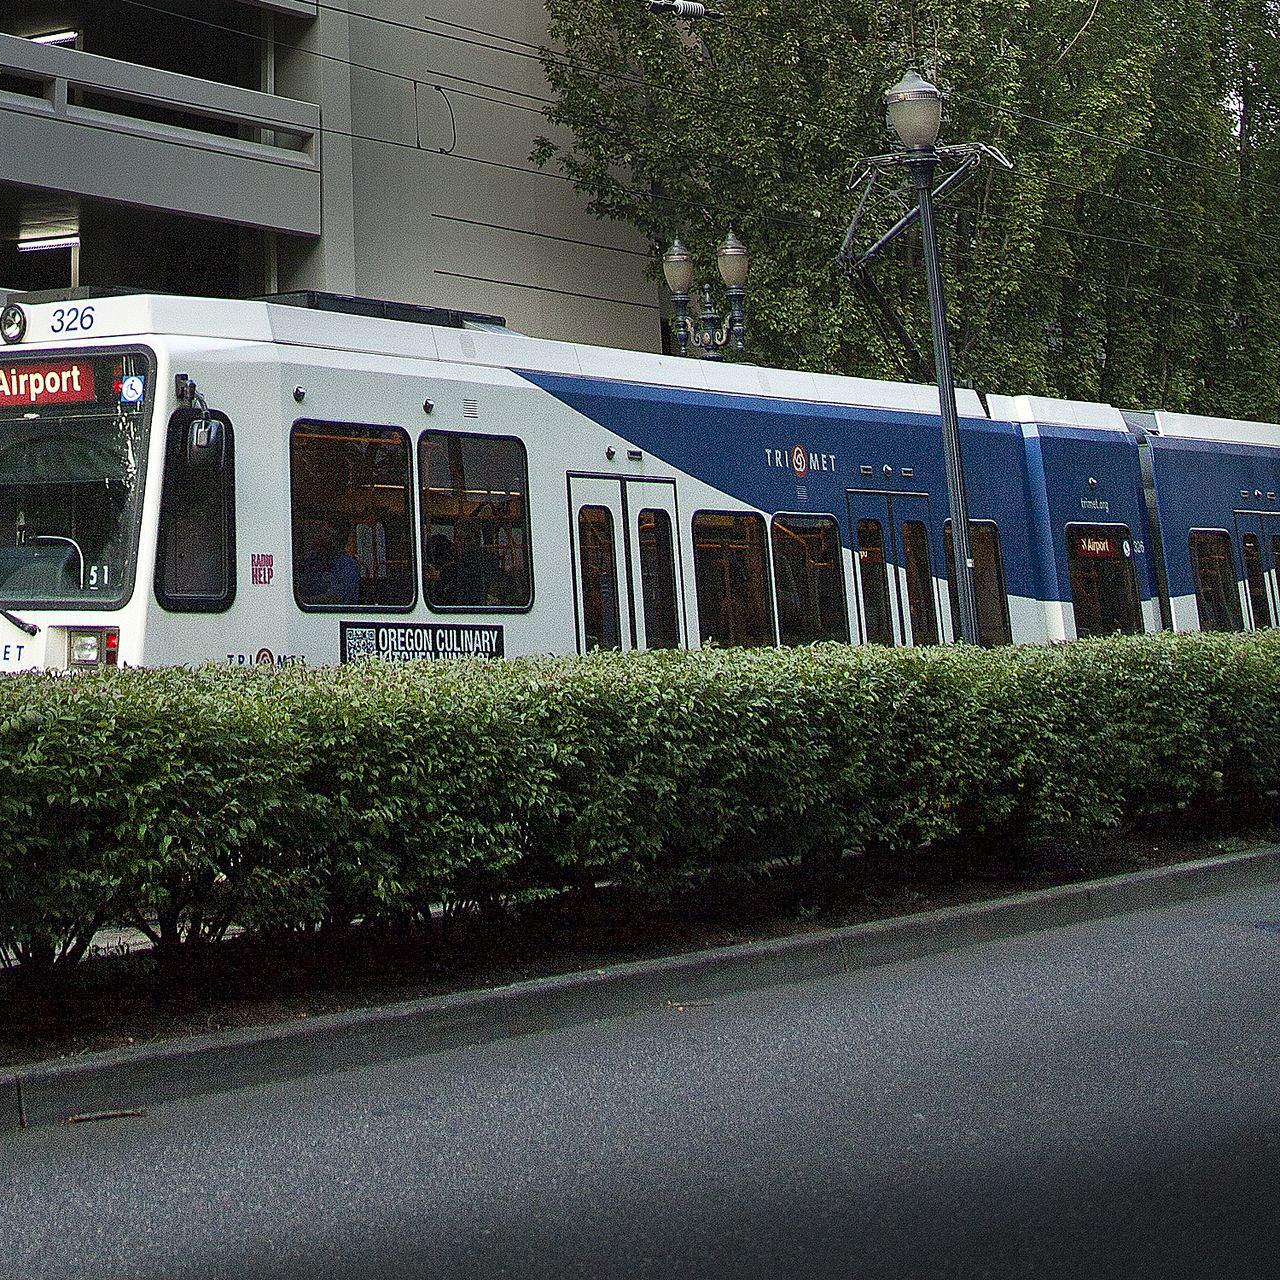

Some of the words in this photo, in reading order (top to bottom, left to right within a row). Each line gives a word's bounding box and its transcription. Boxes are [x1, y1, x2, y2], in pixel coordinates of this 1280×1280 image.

[50, 306, 95, 333] 326
[1080, 496, 1110, 513] trimet.org
[1087, 538, 1110, 554] Airport
[251, 553, 274, 567] RADIO
[251, 568, 274, 585] HELP
[378, 627, 433, 652] OREGON
[436, 628, 499, 653] CULINARY
